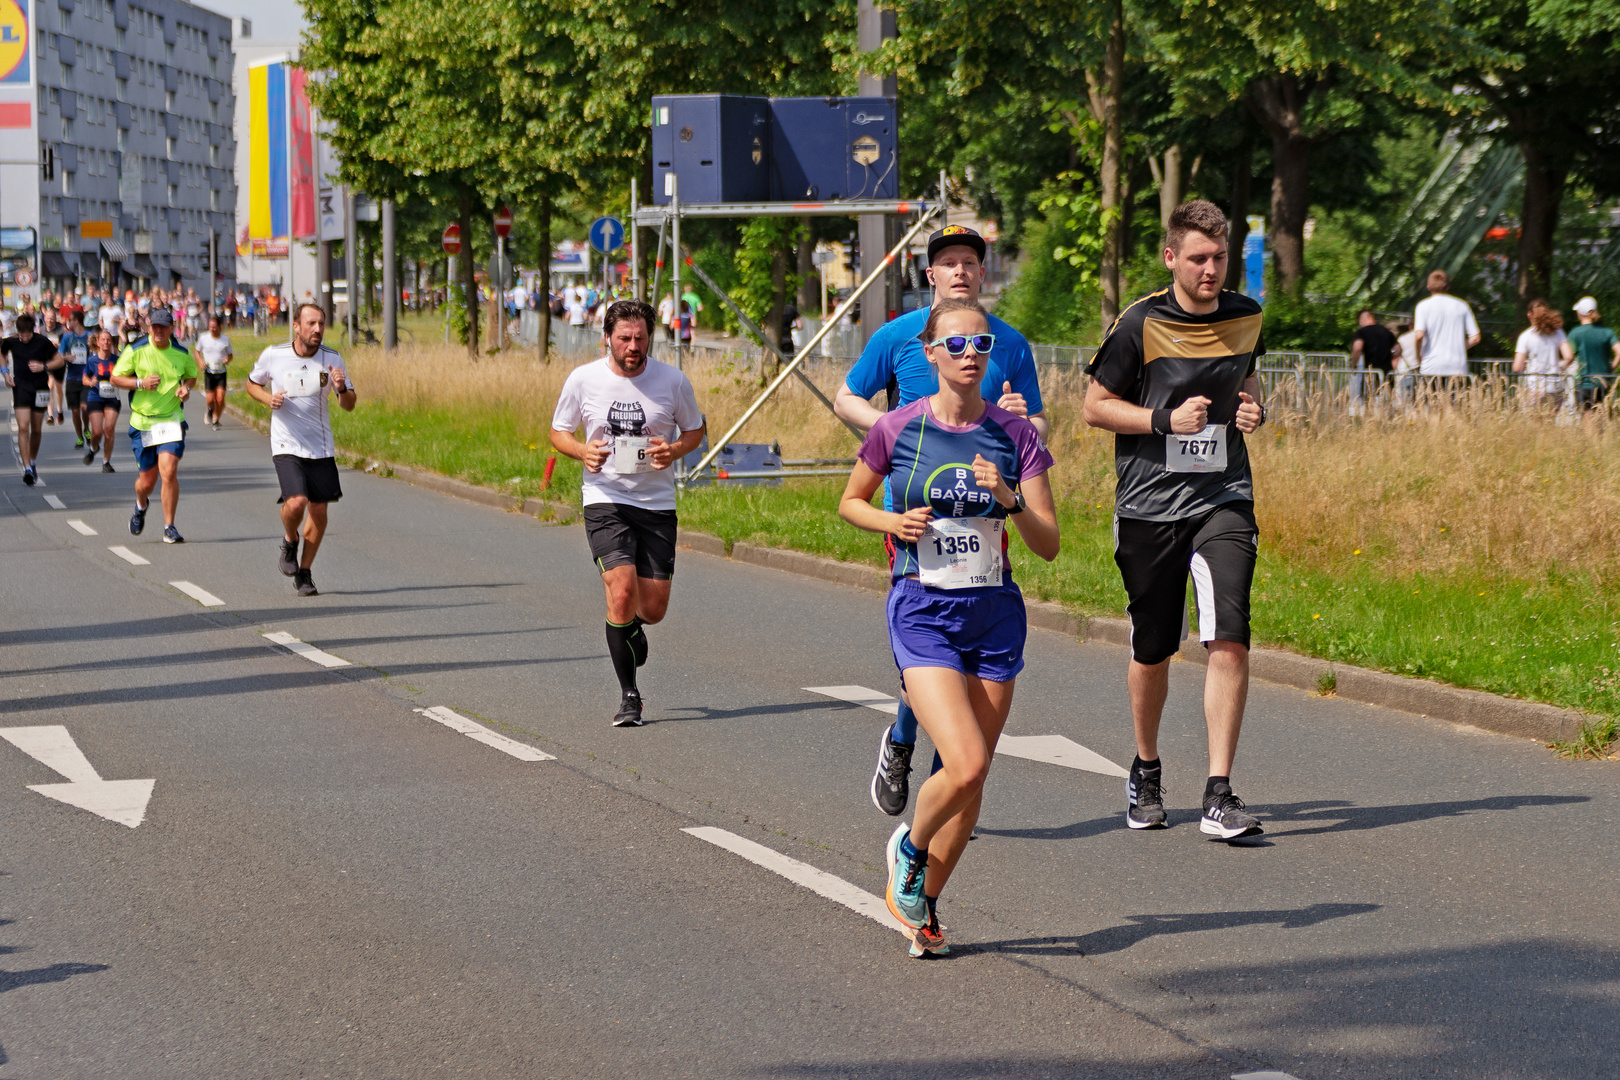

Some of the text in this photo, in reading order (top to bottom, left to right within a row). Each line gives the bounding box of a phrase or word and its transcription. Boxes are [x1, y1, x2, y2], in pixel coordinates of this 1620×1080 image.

[611, 400, 642, 411] FUPPES
[611, 411, 643, 421] FREUNDE
[620, 420, 634, 430] HS
[1179, 440, 1218, 455] 7677
[637, 448, 645, 460] 6
[930, 487, 991, 504] BAYER
[953, 468, 967, 517] BAYER
[933, 534, 980, 556] 1356
[969, 575, 988, 584] 1356
